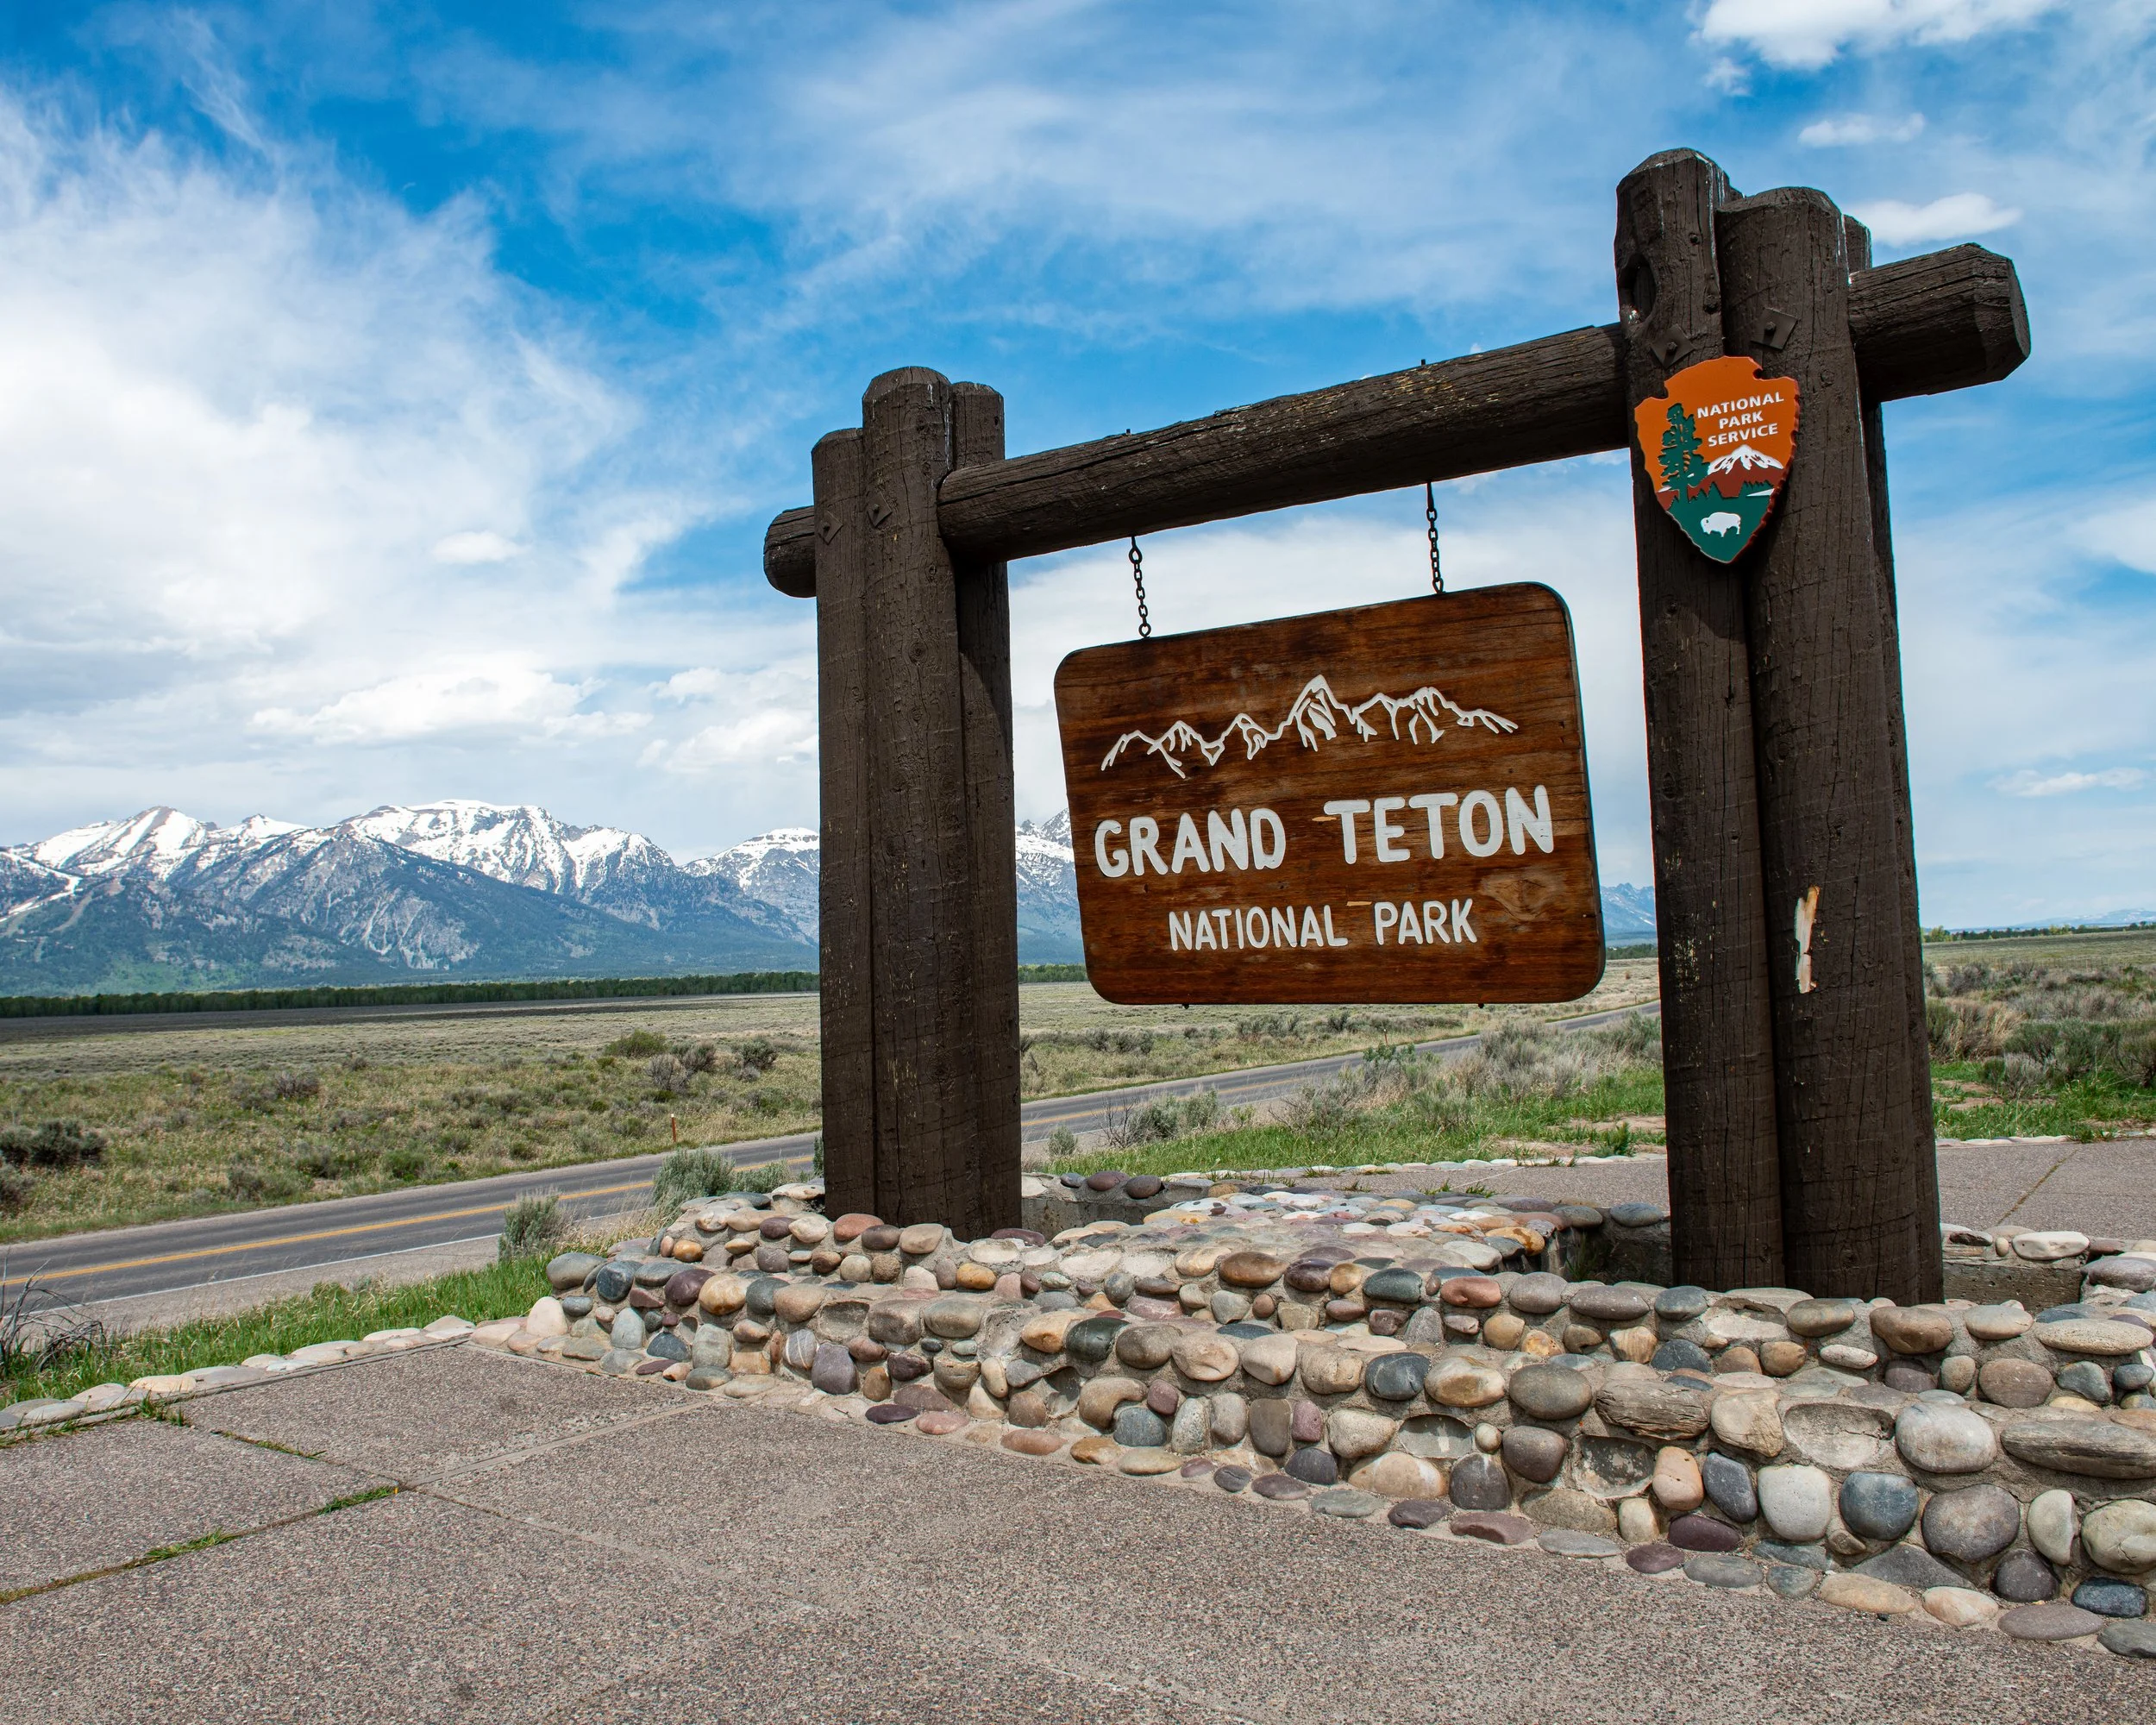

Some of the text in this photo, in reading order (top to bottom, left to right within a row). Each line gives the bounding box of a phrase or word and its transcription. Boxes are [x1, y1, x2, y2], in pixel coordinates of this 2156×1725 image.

[1697, 392, 1784, 418] NATIONAL
[1719, 411, 1764, 429] PARK
[1708, 423, 1778, 447] SERVICE
[1094, 785, 1554, 878] GRAND TETON
[1169, 898, 1477, 950] NATIONAL PARK
